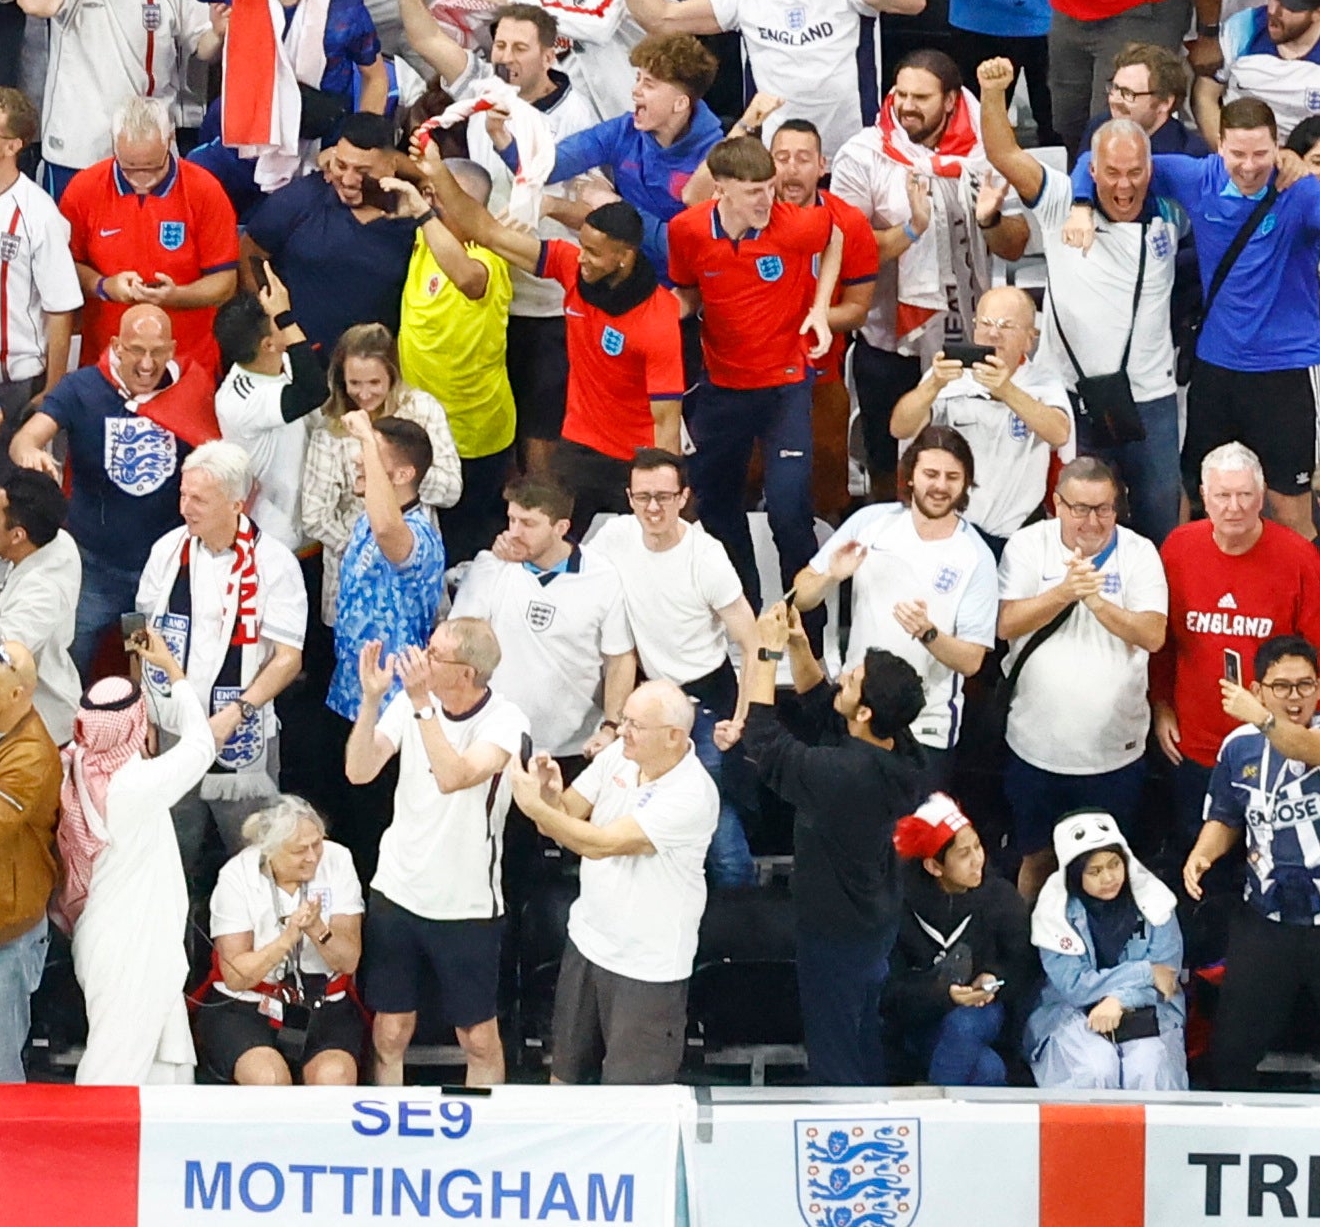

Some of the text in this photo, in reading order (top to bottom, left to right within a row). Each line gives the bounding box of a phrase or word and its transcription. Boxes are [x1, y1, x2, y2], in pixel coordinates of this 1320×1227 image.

[757, 21, 834, 47] ENGLAND
[1186, 610, 1273, 639] ENGLAND
[351, 1100, 472, 1140] SE9
[183, 1159, 635, 1222] MOTTINGHAM
